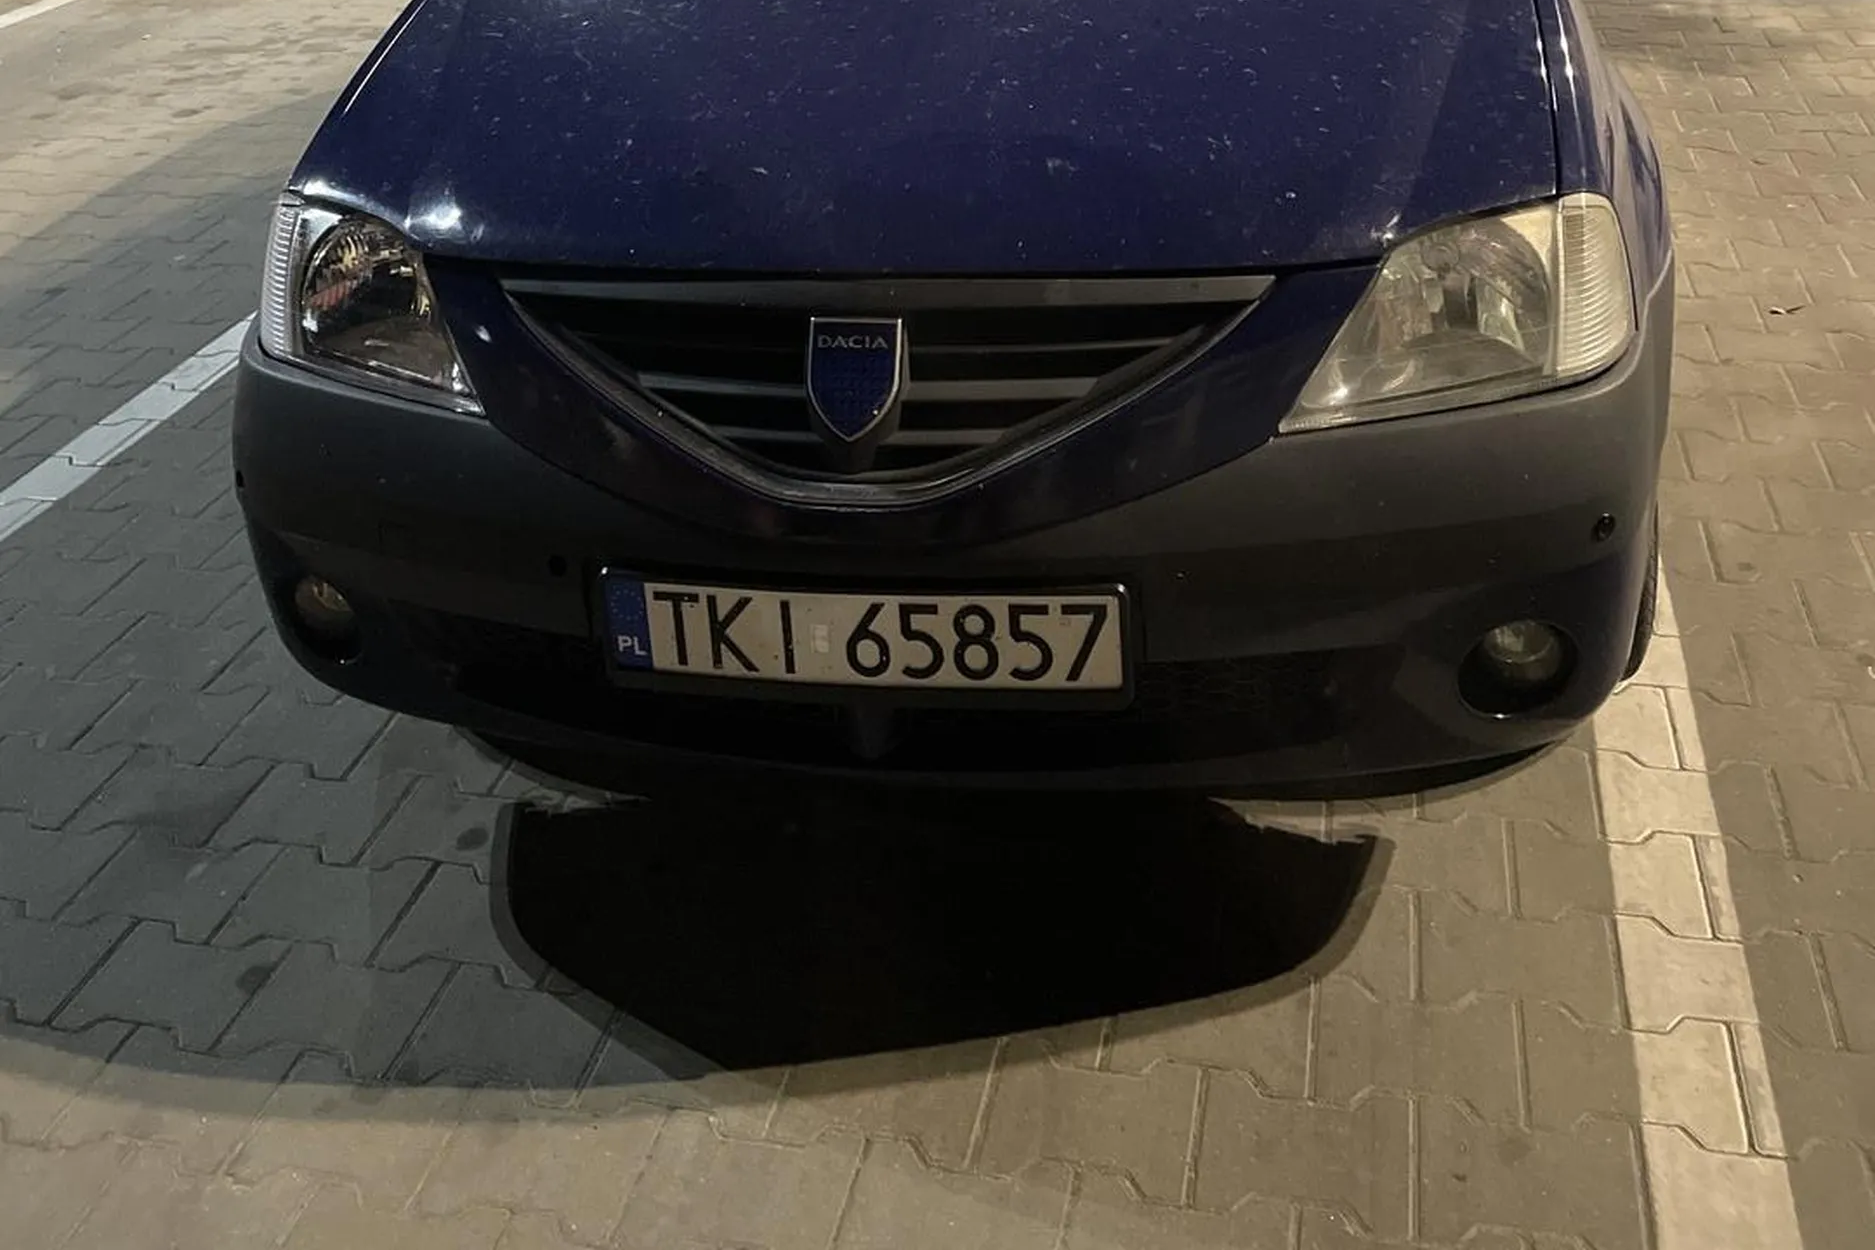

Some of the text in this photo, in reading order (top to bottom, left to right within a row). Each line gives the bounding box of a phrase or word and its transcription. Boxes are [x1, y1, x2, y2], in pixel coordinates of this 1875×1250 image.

[818, 336, 888, 348] DACIA
[617, 636, 647, 657] PL
[653, 593, 1110, 682] TKI 65857
